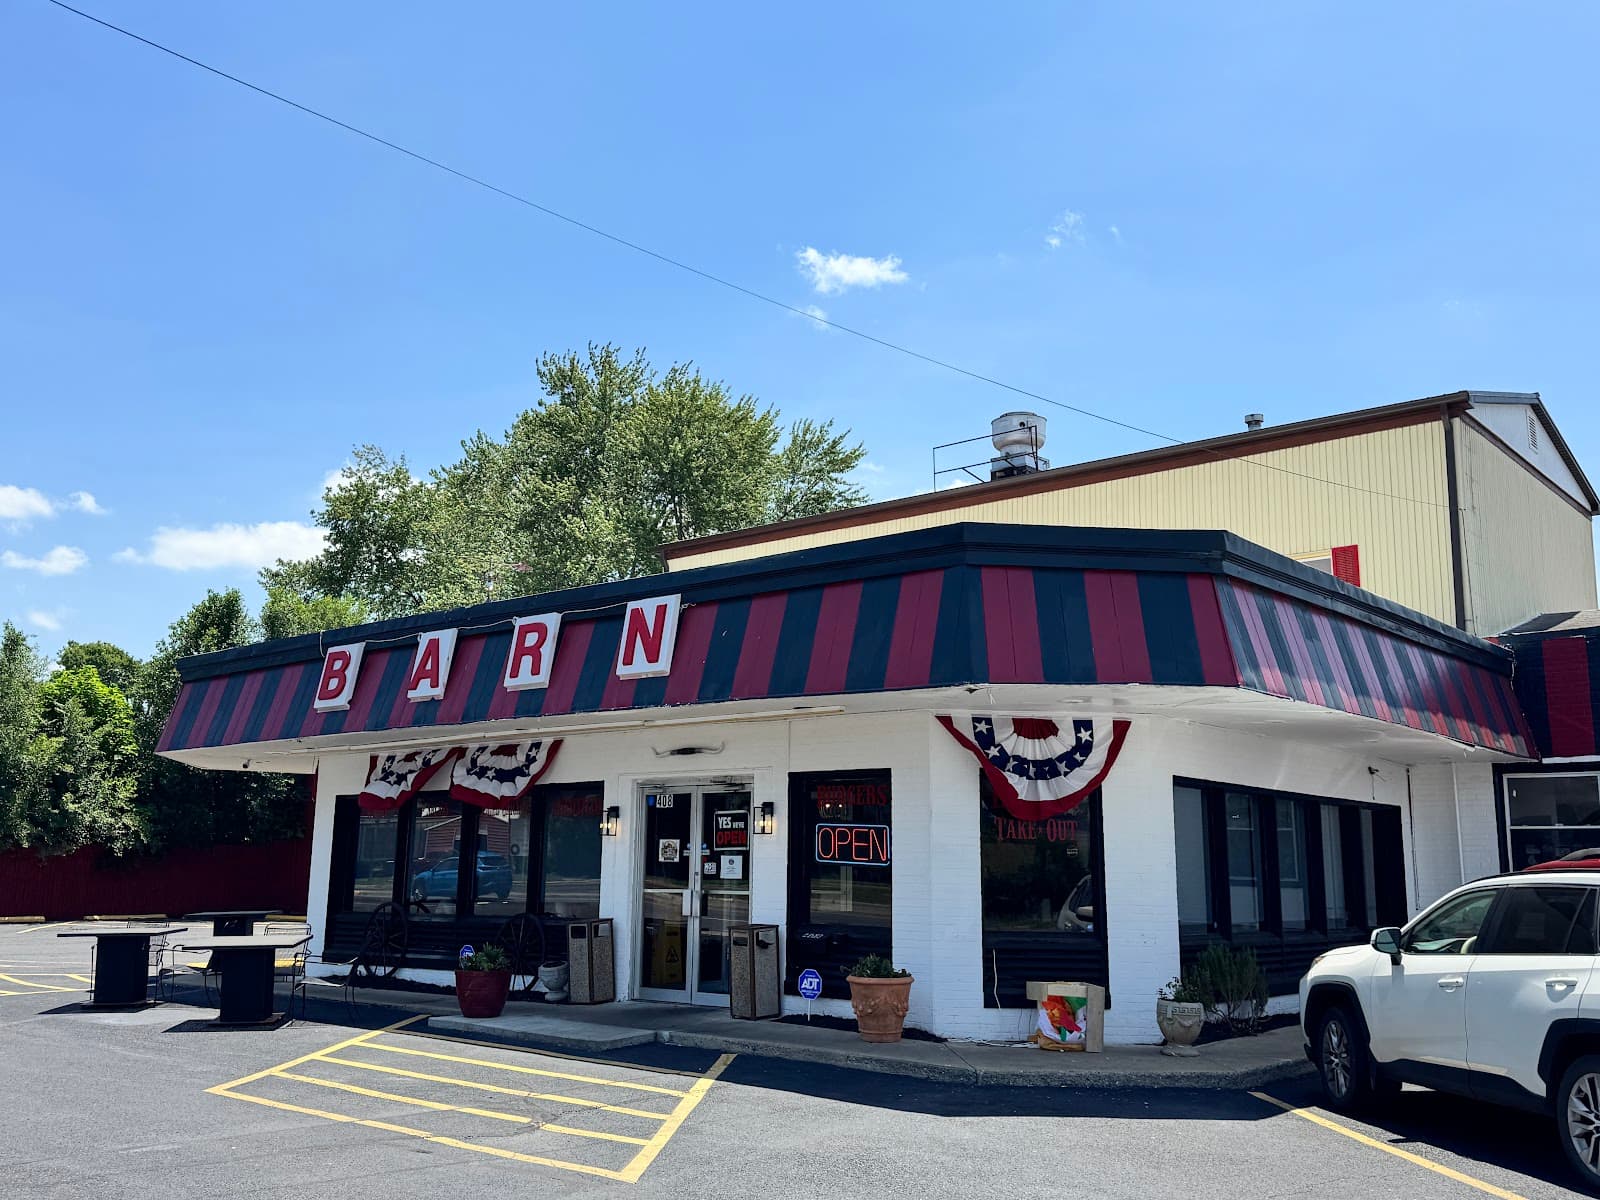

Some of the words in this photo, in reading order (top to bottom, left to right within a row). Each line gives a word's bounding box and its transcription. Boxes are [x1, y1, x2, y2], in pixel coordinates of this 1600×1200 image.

[318, 604, 667, 700] BARN
[657, 795, 672, 807] 408
[718, 817, 731, 829] YES
[716, 831, 747, 845] OPEN
[818, 827, 887, 861] OPEN
[801, 978, 819, 990] ADT
